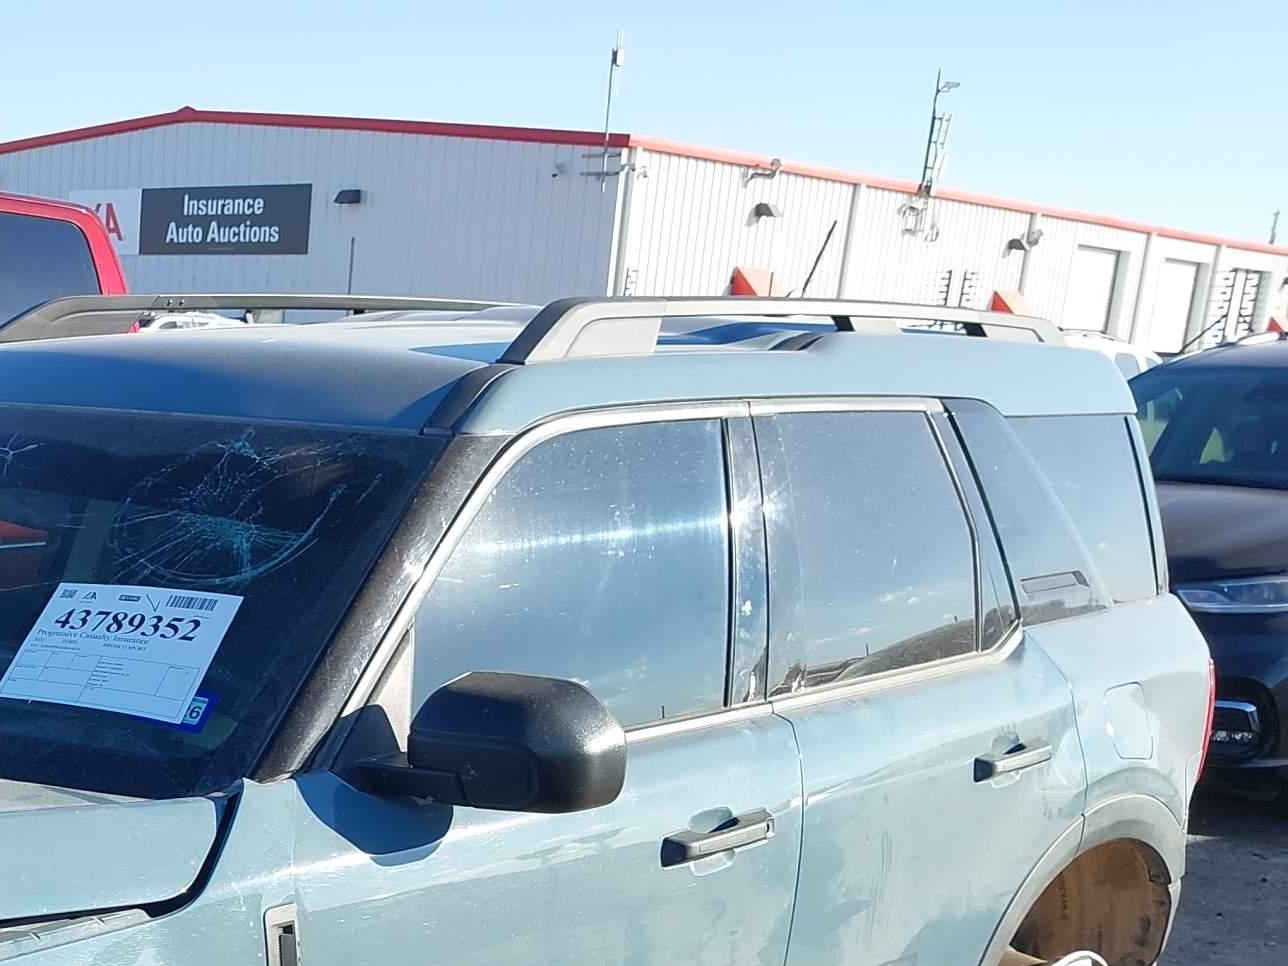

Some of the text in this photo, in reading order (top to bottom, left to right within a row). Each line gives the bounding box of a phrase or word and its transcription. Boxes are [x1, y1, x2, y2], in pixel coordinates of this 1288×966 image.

[183, 194, 264, 216] Insurance
[165, 221, 280, 243] Auto Auctions
[54, 608, 201, 641] 43789352
[37, 629, 150, 644] Progressive Casualty Insurance
